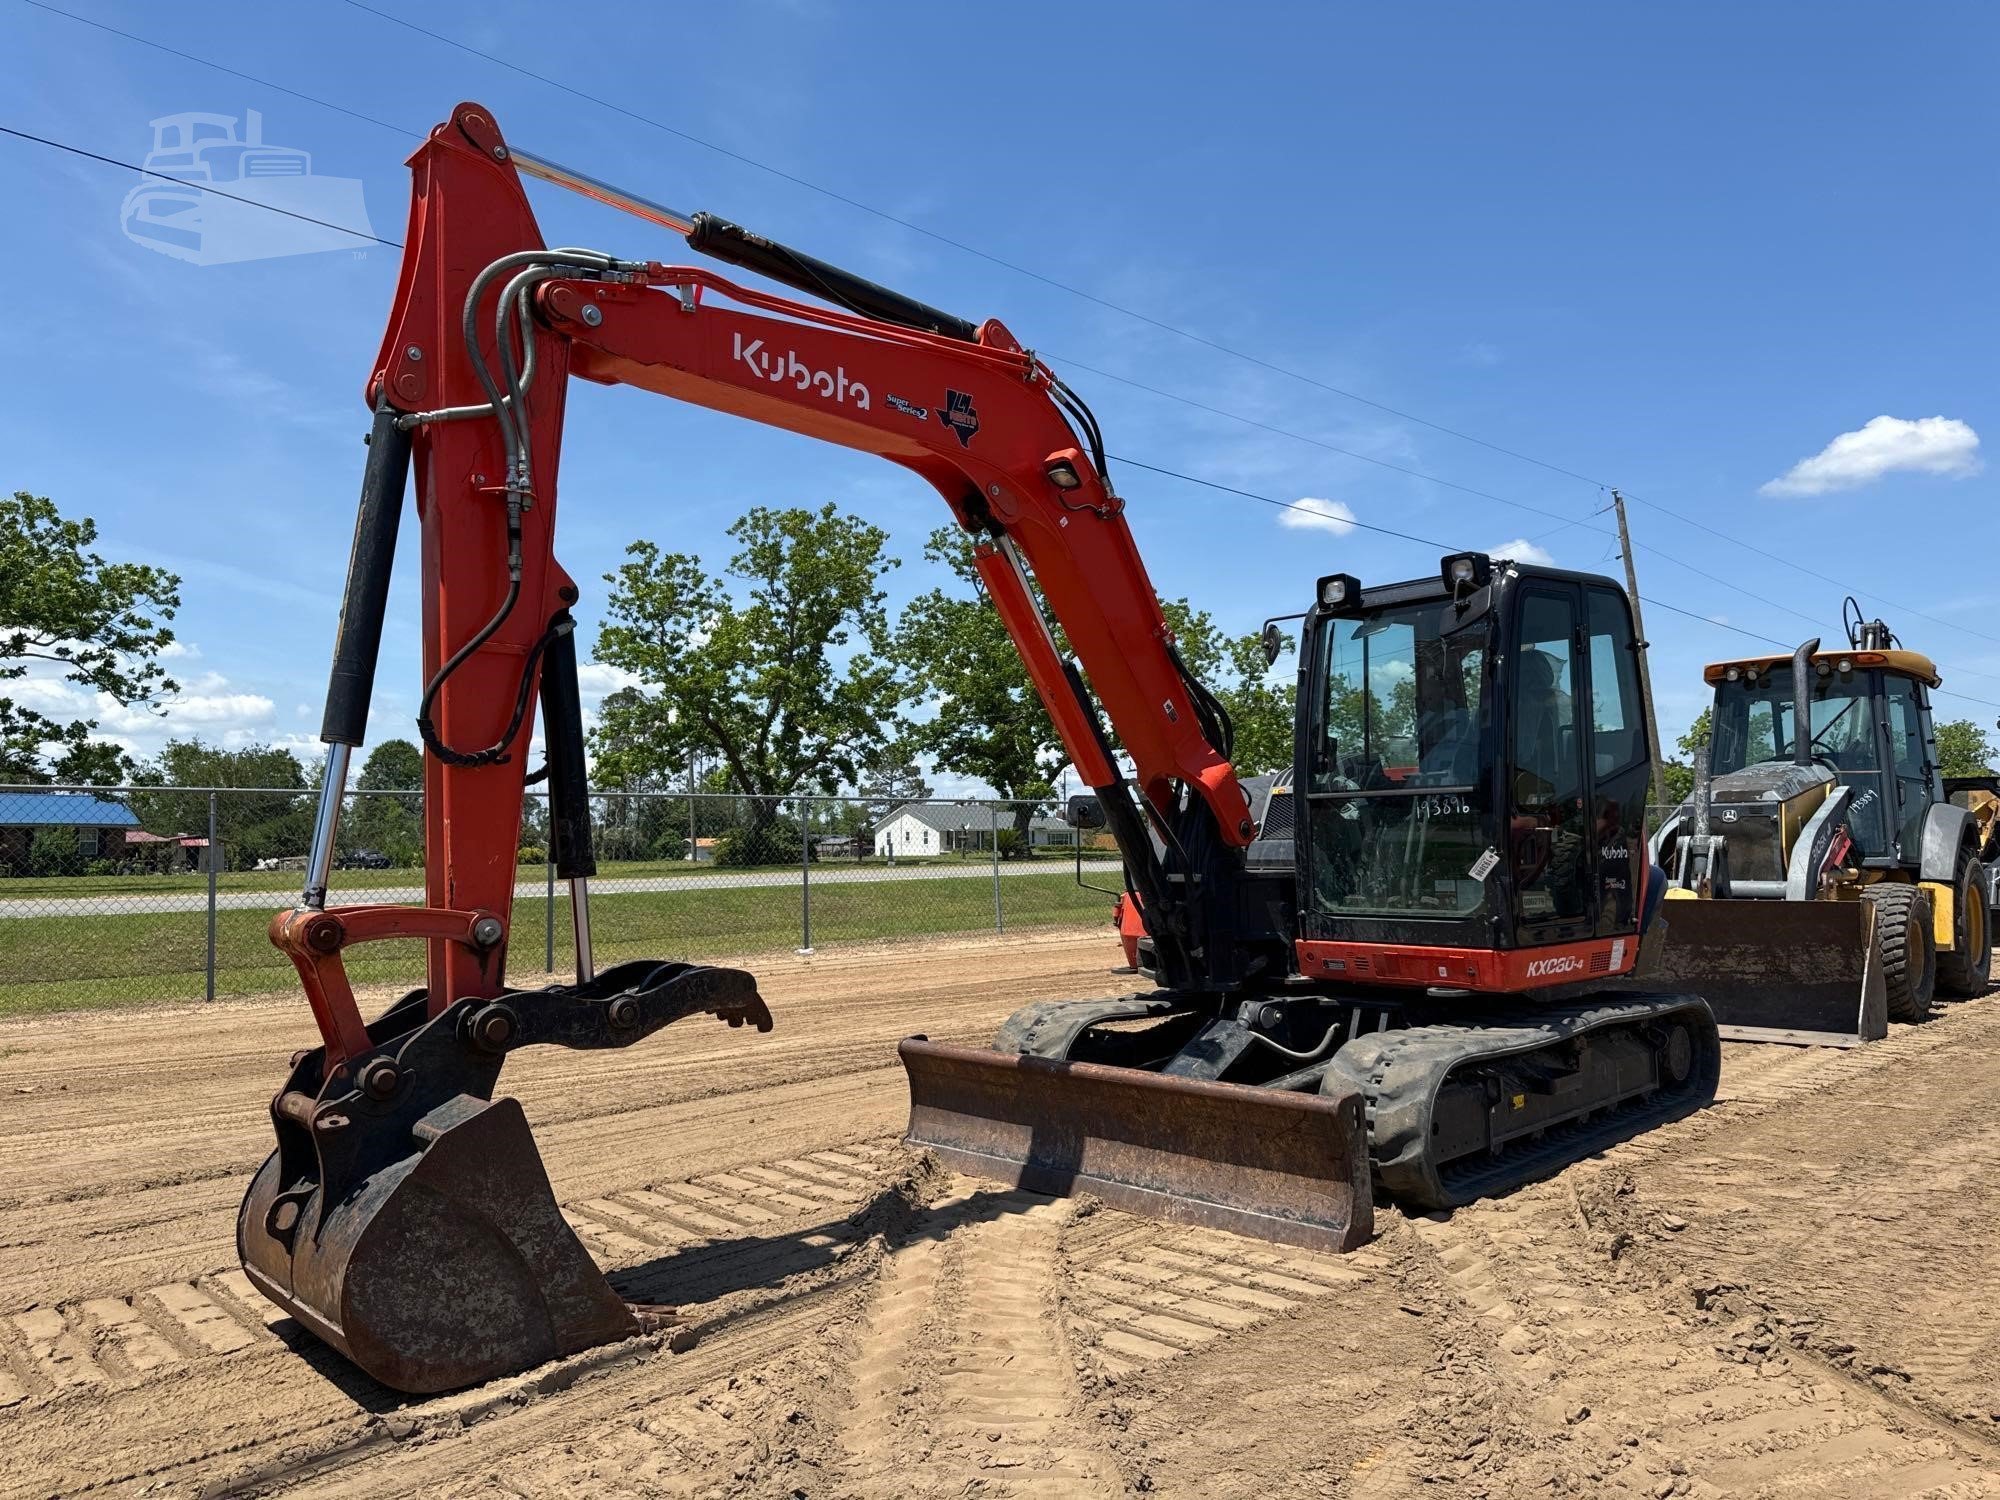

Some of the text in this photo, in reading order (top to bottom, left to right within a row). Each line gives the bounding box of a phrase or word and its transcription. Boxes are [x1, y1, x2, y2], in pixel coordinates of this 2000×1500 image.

[733, 332, 870, 411] Kubota
[887, 393, 910, 406] Super
[1416, 796, 1470, 819] 193896
[1849, 789, 1878, 814] 193889
[1601, 846, 1628, 859] Kubota
